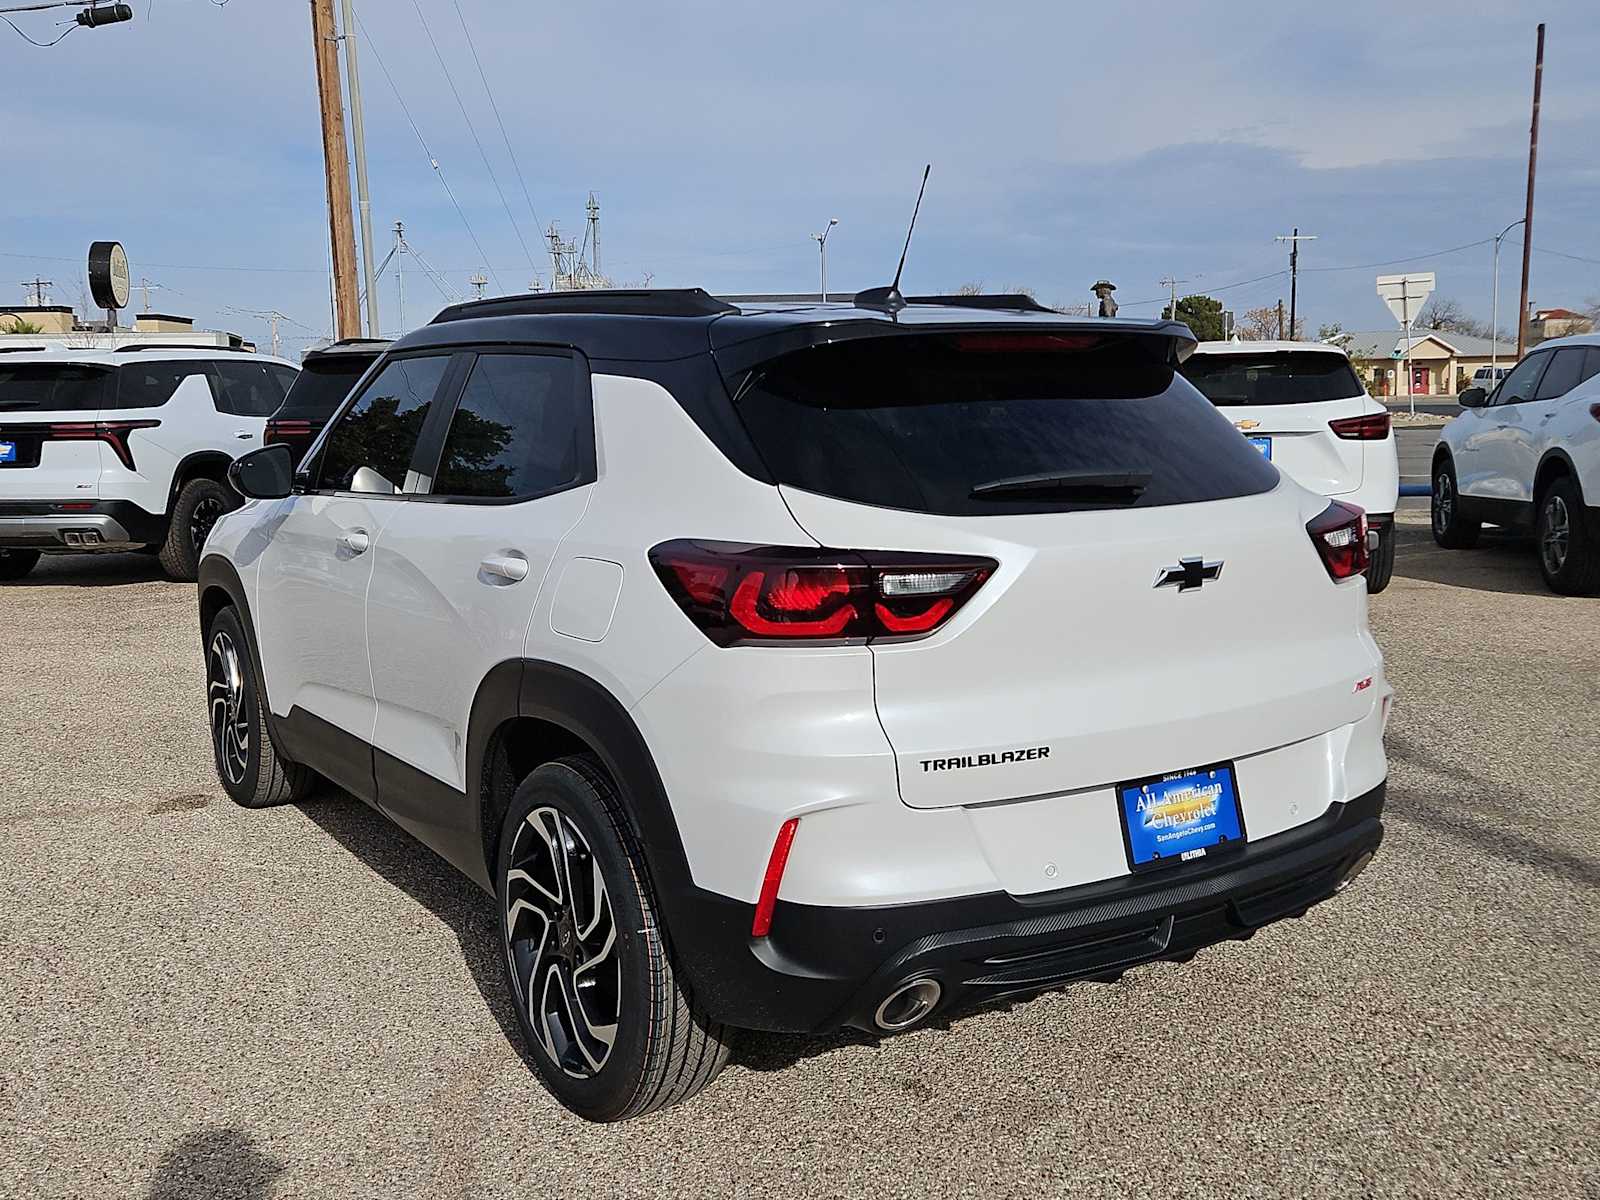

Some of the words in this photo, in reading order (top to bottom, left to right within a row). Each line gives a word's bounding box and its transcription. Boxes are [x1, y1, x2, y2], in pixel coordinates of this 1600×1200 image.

[919, 746, 1050, 772] TRAILBLAZER
[1136, 792, 1156, 812] All
[1161, 782, 1223, 806] American
[1152, 801, 1217, 829] Chevrolet
[1156, 822, 1216, 843] SanAngeloChevy.com
